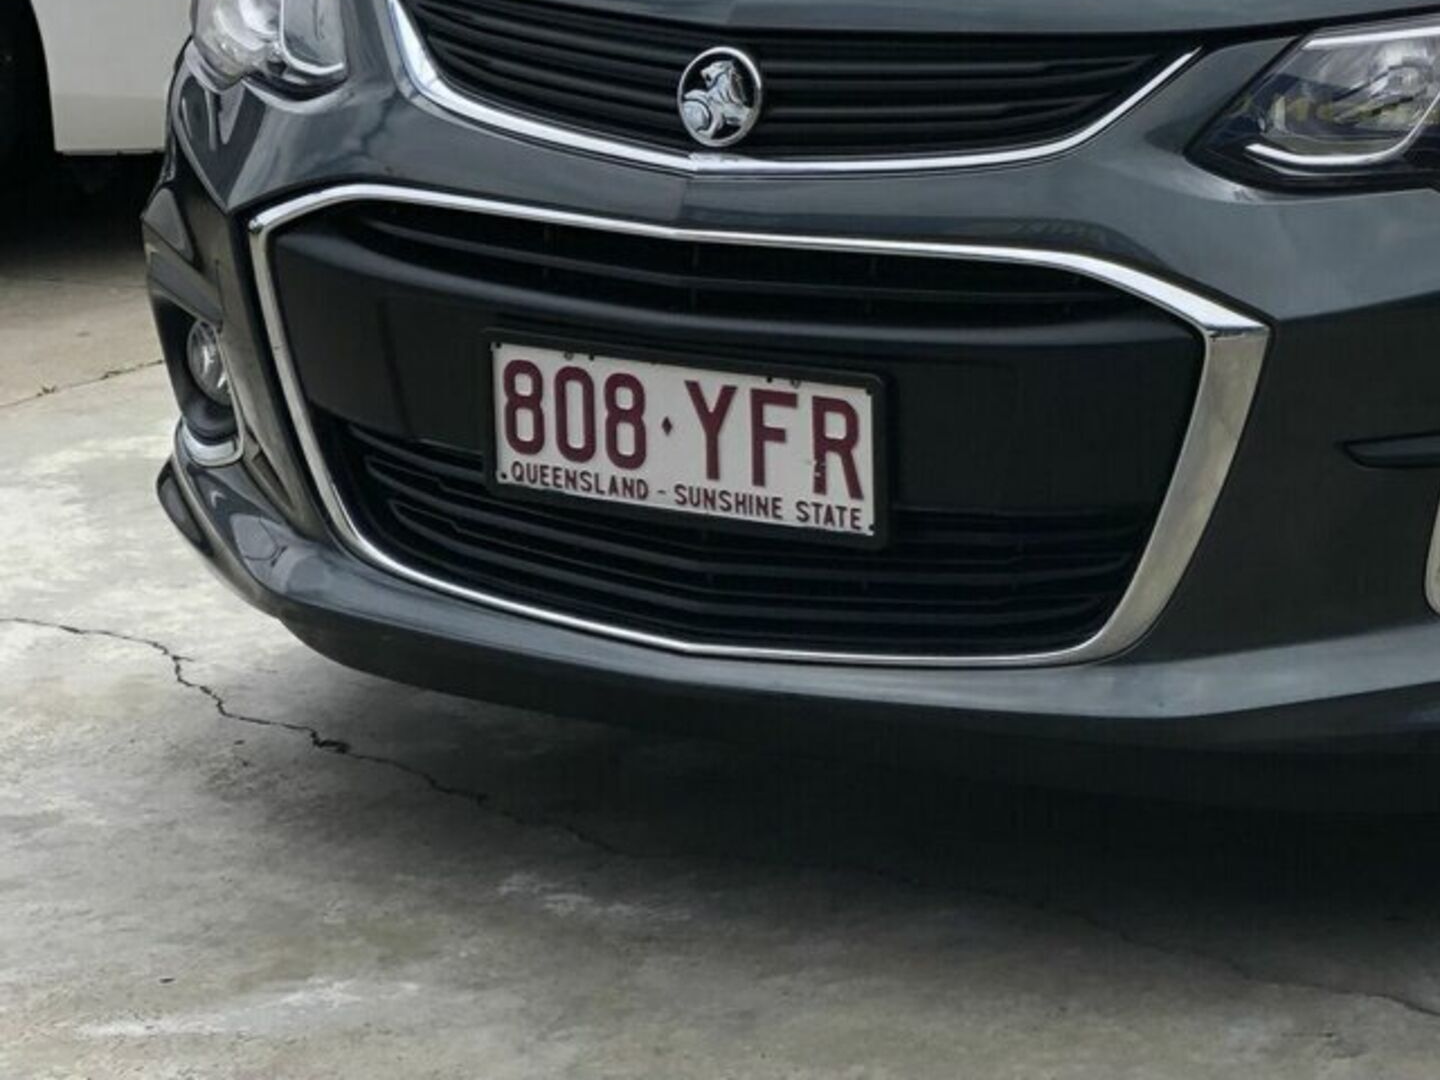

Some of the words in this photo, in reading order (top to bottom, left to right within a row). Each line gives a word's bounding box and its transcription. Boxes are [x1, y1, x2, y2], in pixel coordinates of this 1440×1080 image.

[511, 460, 650, 501] QUEENSLAND
[674, 482, 783, 519] SUNSHINE
[795, 499, 863, 531] STATE
